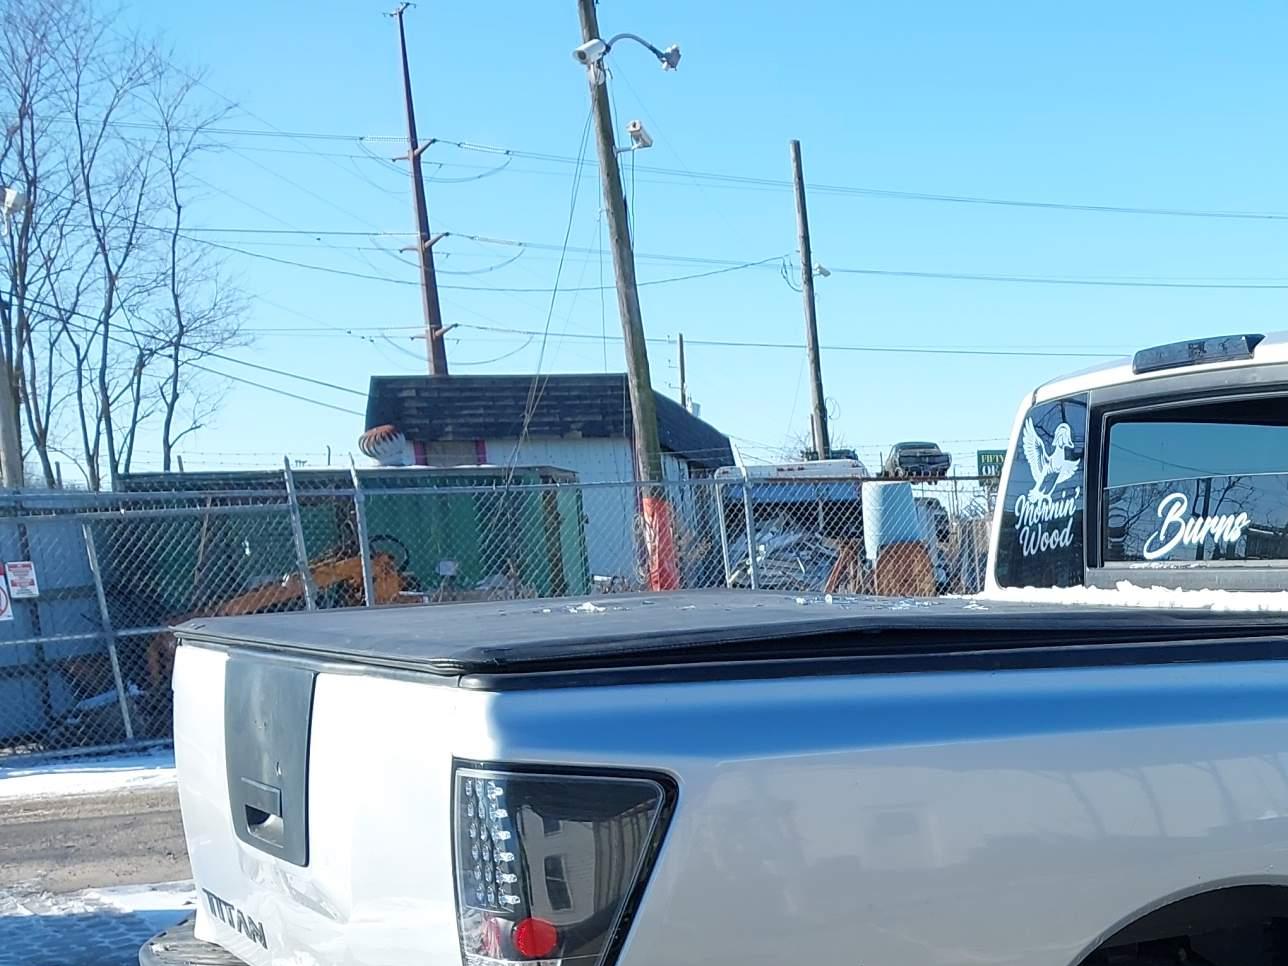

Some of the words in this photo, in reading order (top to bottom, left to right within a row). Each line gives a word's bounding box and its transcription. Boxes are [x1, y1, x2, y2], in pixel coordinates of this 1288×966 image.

[1019, 517, 1075, 557] Wood
[1143, 492, 1251, 560] Burns
[202, 887, 269, 950] TITAN
